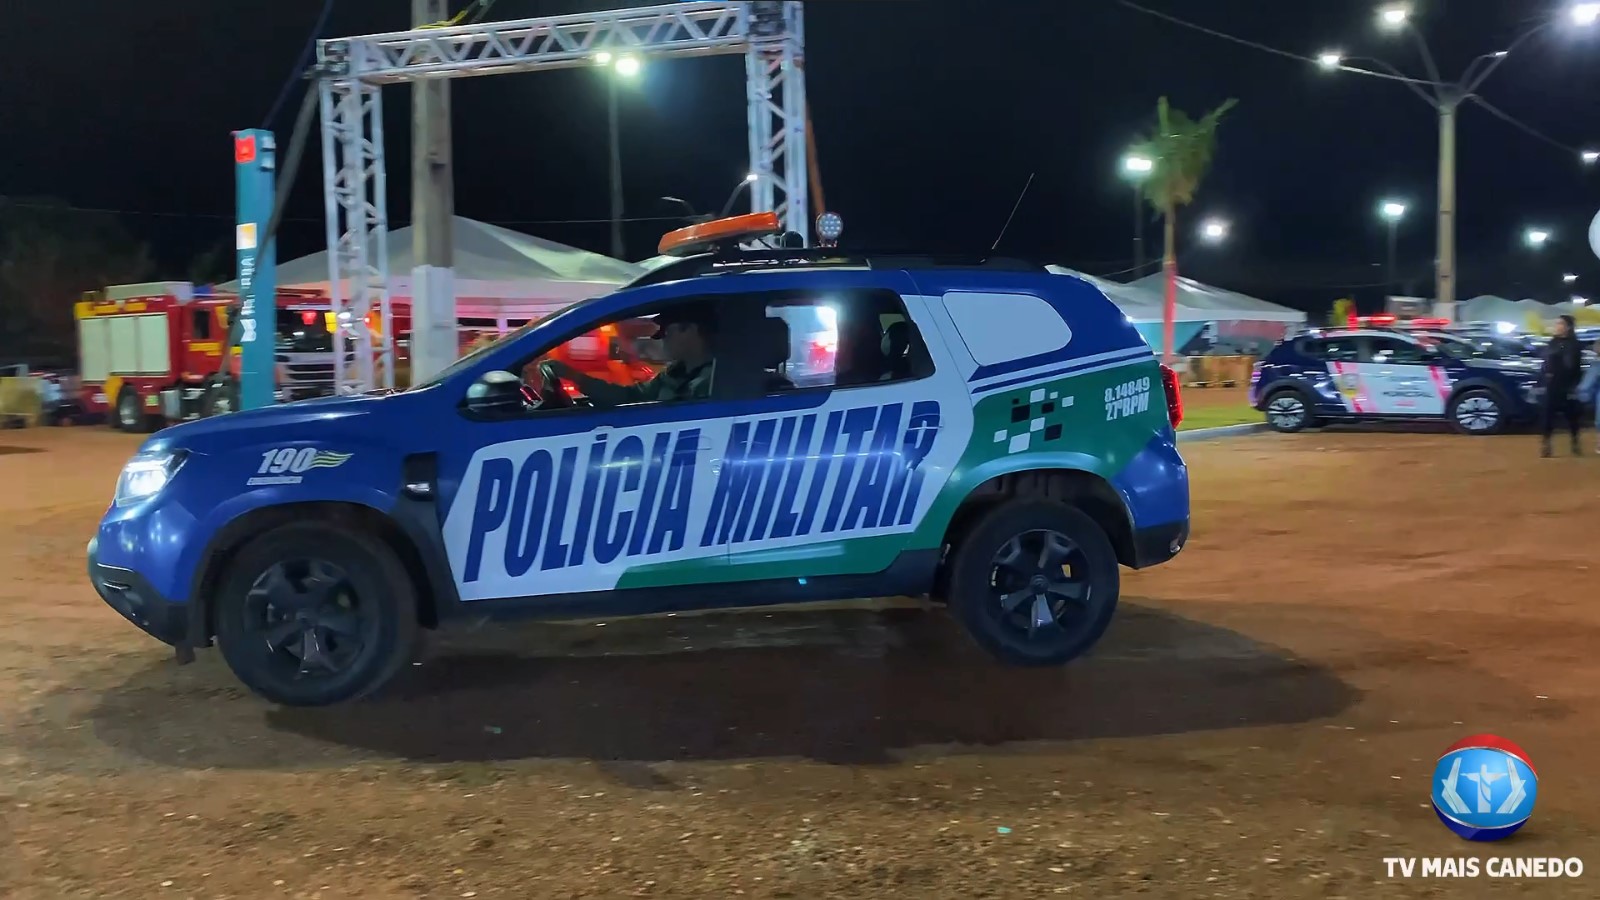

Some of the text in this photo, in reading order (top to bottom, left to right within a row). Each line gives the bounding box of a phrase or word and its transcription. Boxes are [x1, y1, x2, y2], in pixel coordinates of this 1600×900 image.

[1104, 376, 1150, 402] 8.14849
[258, 447, 317, 474] 190
[699, 401, 941, 549] MILITAR
